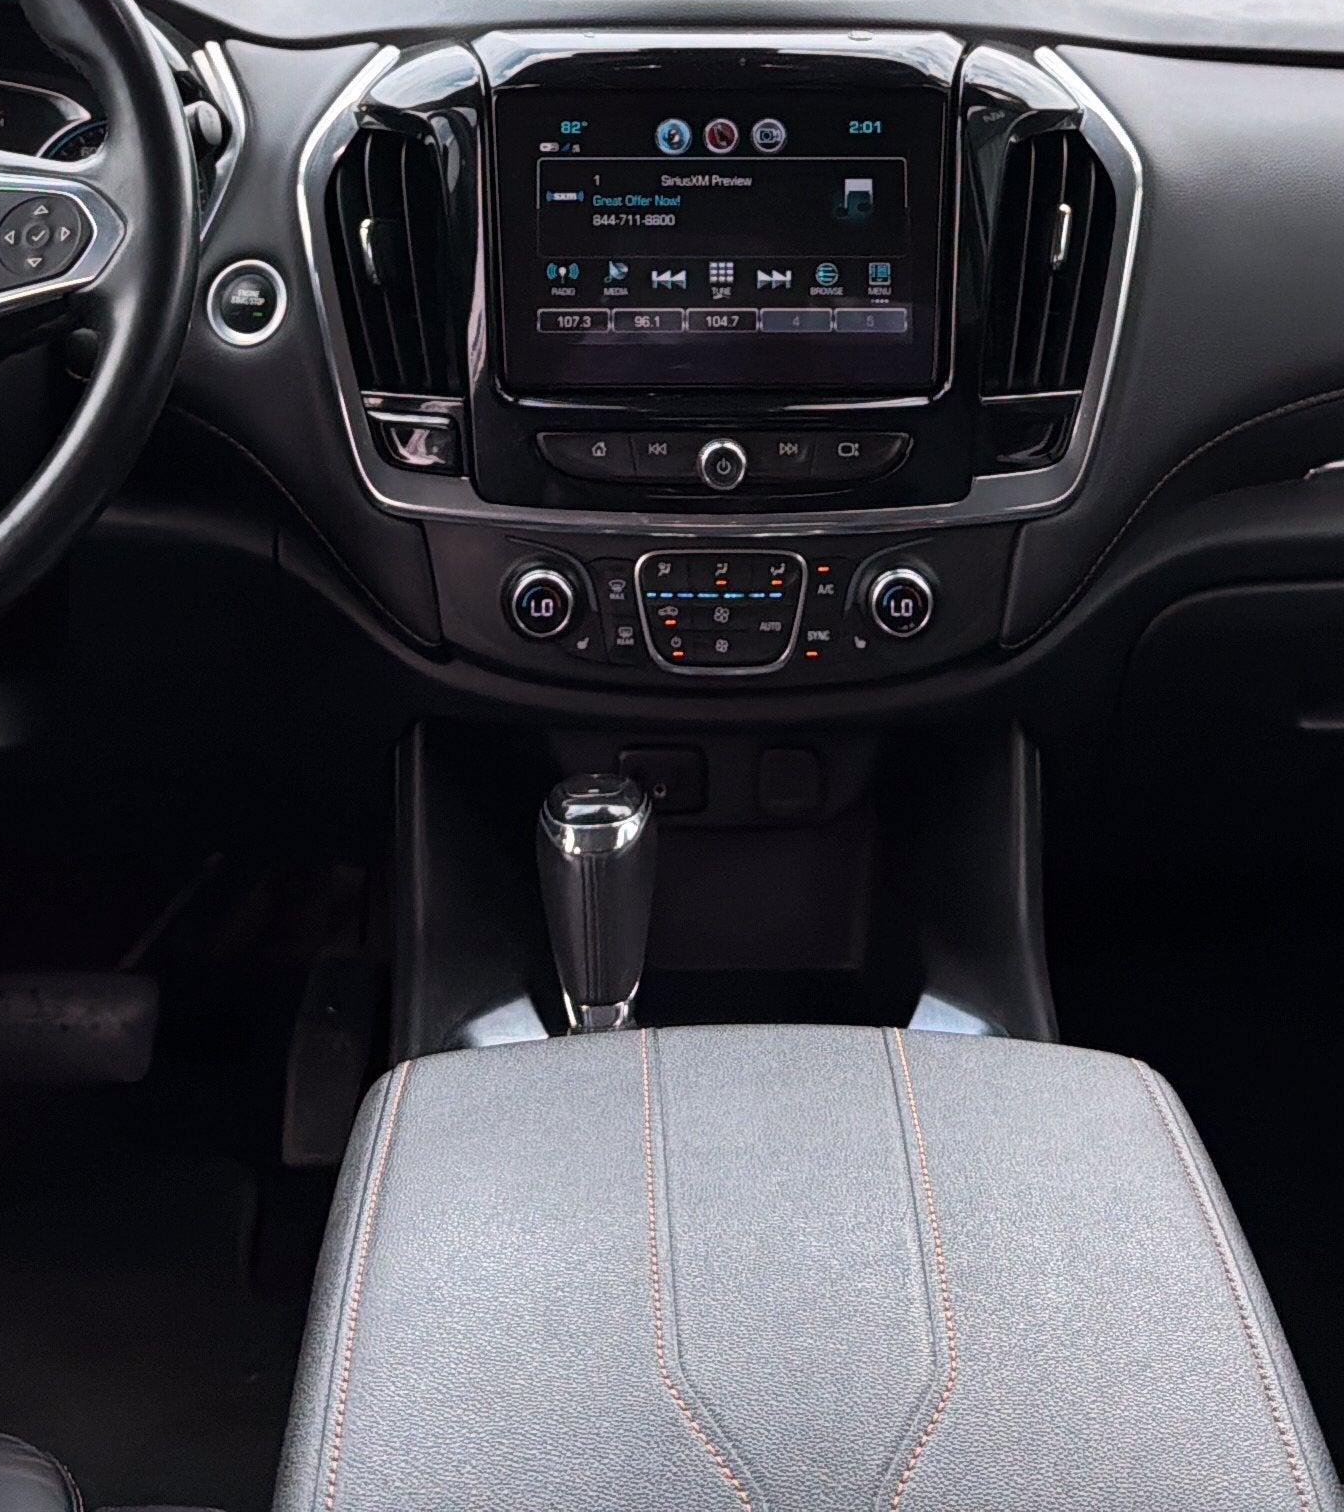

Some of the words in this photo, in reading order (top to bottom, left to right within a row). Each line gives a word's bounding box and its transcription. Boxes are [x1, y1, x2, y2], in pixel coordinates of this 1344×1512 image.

[560, 121, 588, 134] 82°
[849, 120, 882, 134] 2:01
[593, 174, 600, 186] 1
[661, 174, 709, 186] SiriusXM
[712, 174, 752, 186] Preview
[593, 195, 622, 207] Great
[625, 195, 652, 207] Offer
[655, 195, 681, 207] Now!
[551, 287, 576, 296] RADIO
[603, 287, 629, 296] MEDIA
[810, 287, 843, 296] BROWSE
[867, 287, 892, 296] MENU
[557, 316, 592, 328] 107.3
[634, 316, 661, 328] 96.1
[706, 316, 740, 328] 104.7
[792, 316, 800, 327] 4
[817, 583, 834, 595] A/C
[530, 598, 553, 617] LO
[890, 598, 913, 617] LO
[759, 621, 782, 632] AUTO
[807, 630, 830, 641] SYNC
